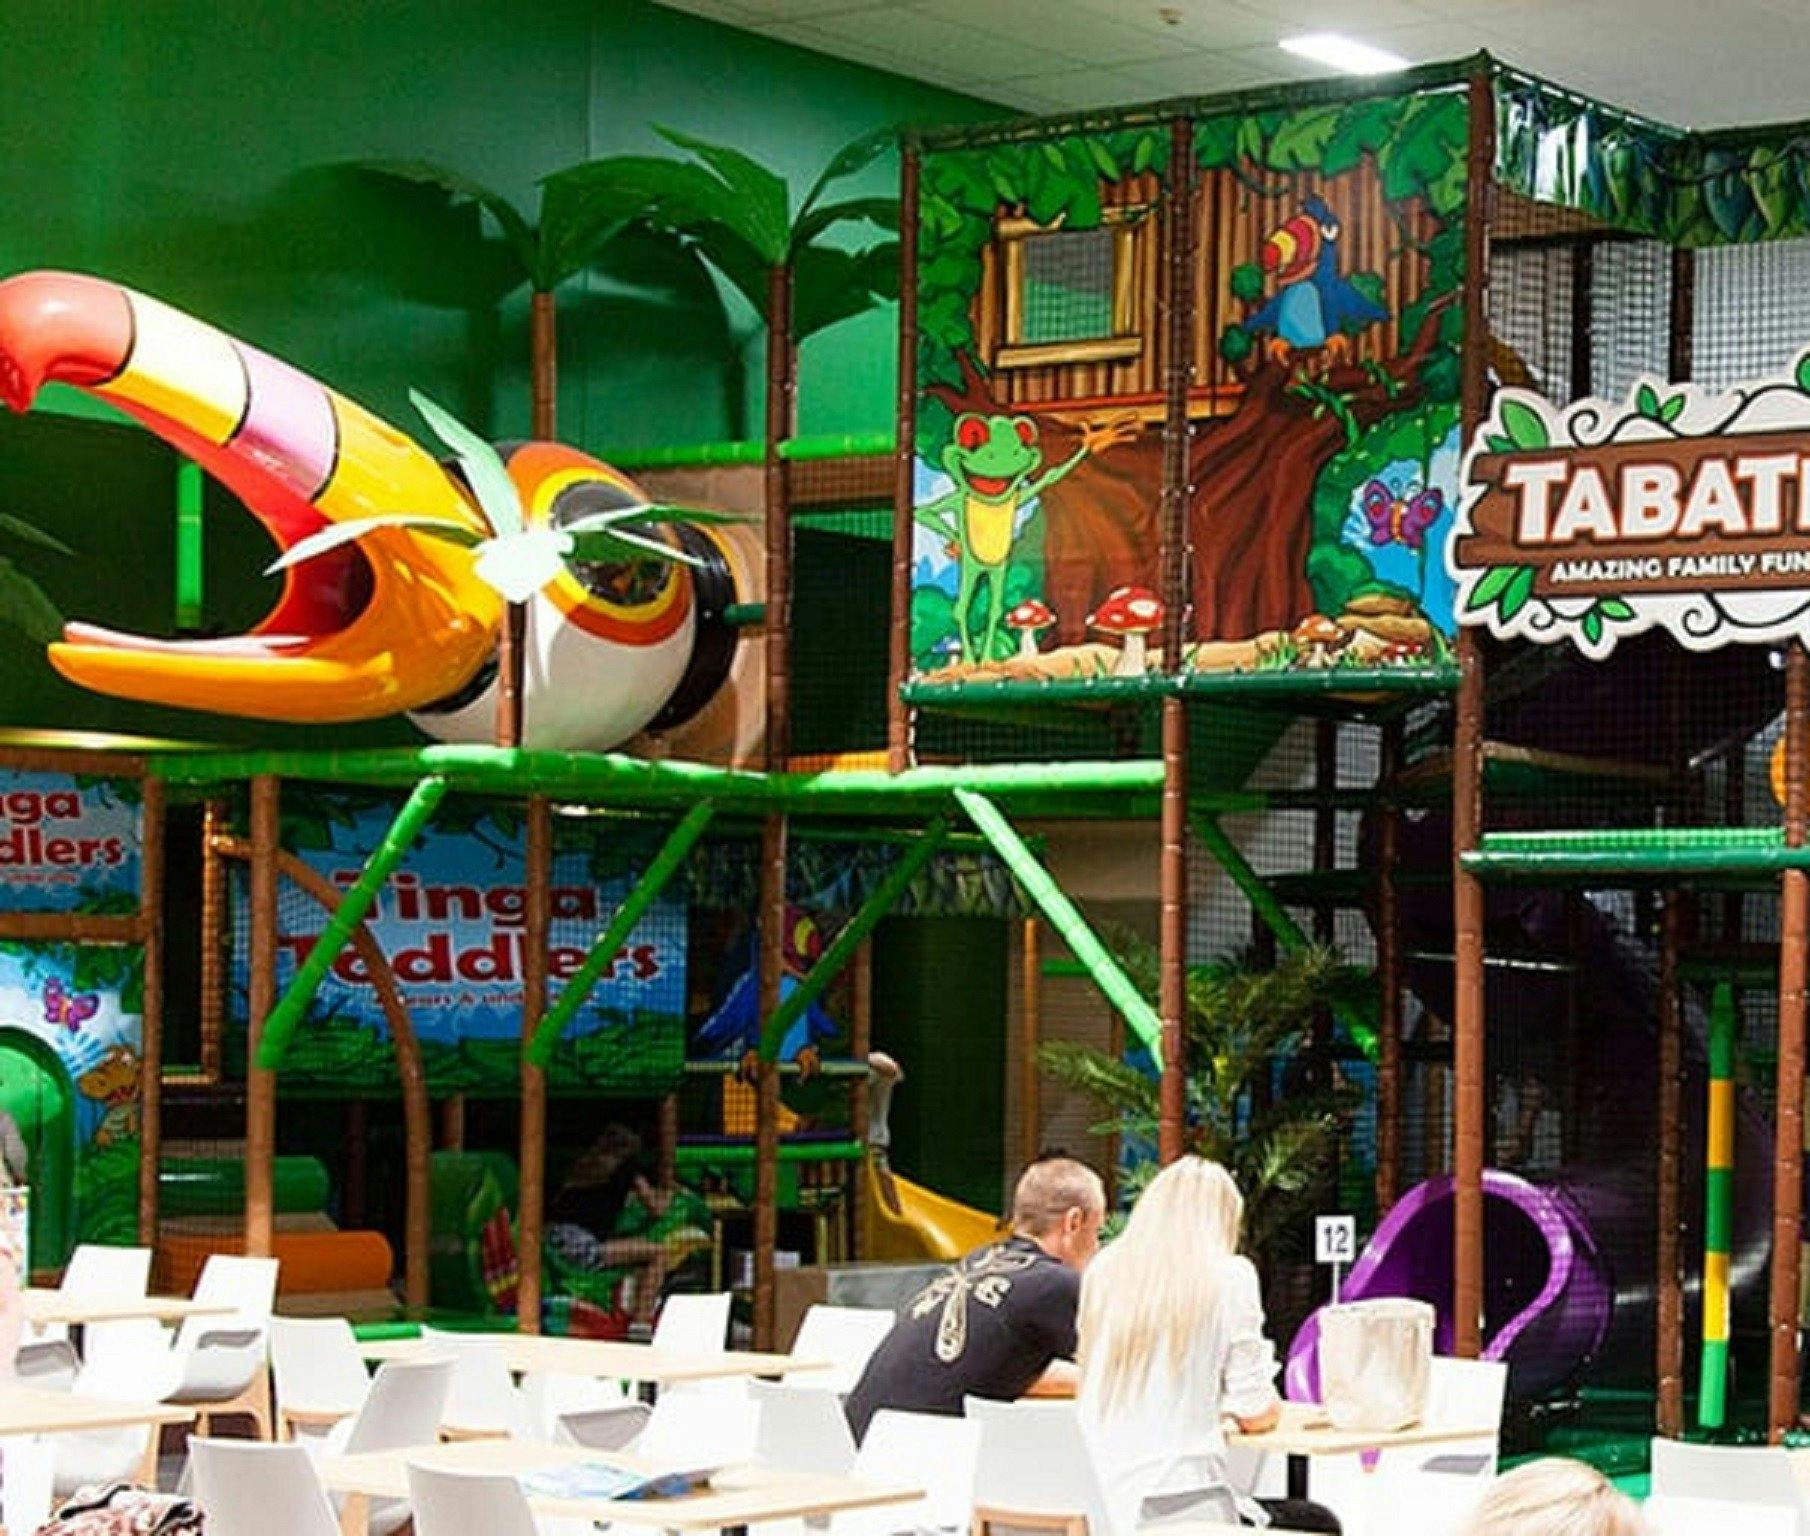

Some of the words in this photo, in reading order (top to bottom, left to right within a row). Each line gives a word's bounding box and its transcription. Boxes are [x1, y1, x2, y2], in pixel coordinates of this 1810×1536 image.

[1551, 559, 1662, 582] AMAZING
[1667, 554, 1755, 577] FAMILY
[0, 792, 81, 824] ga
[1324, 1225, 1349, 1253] 12
